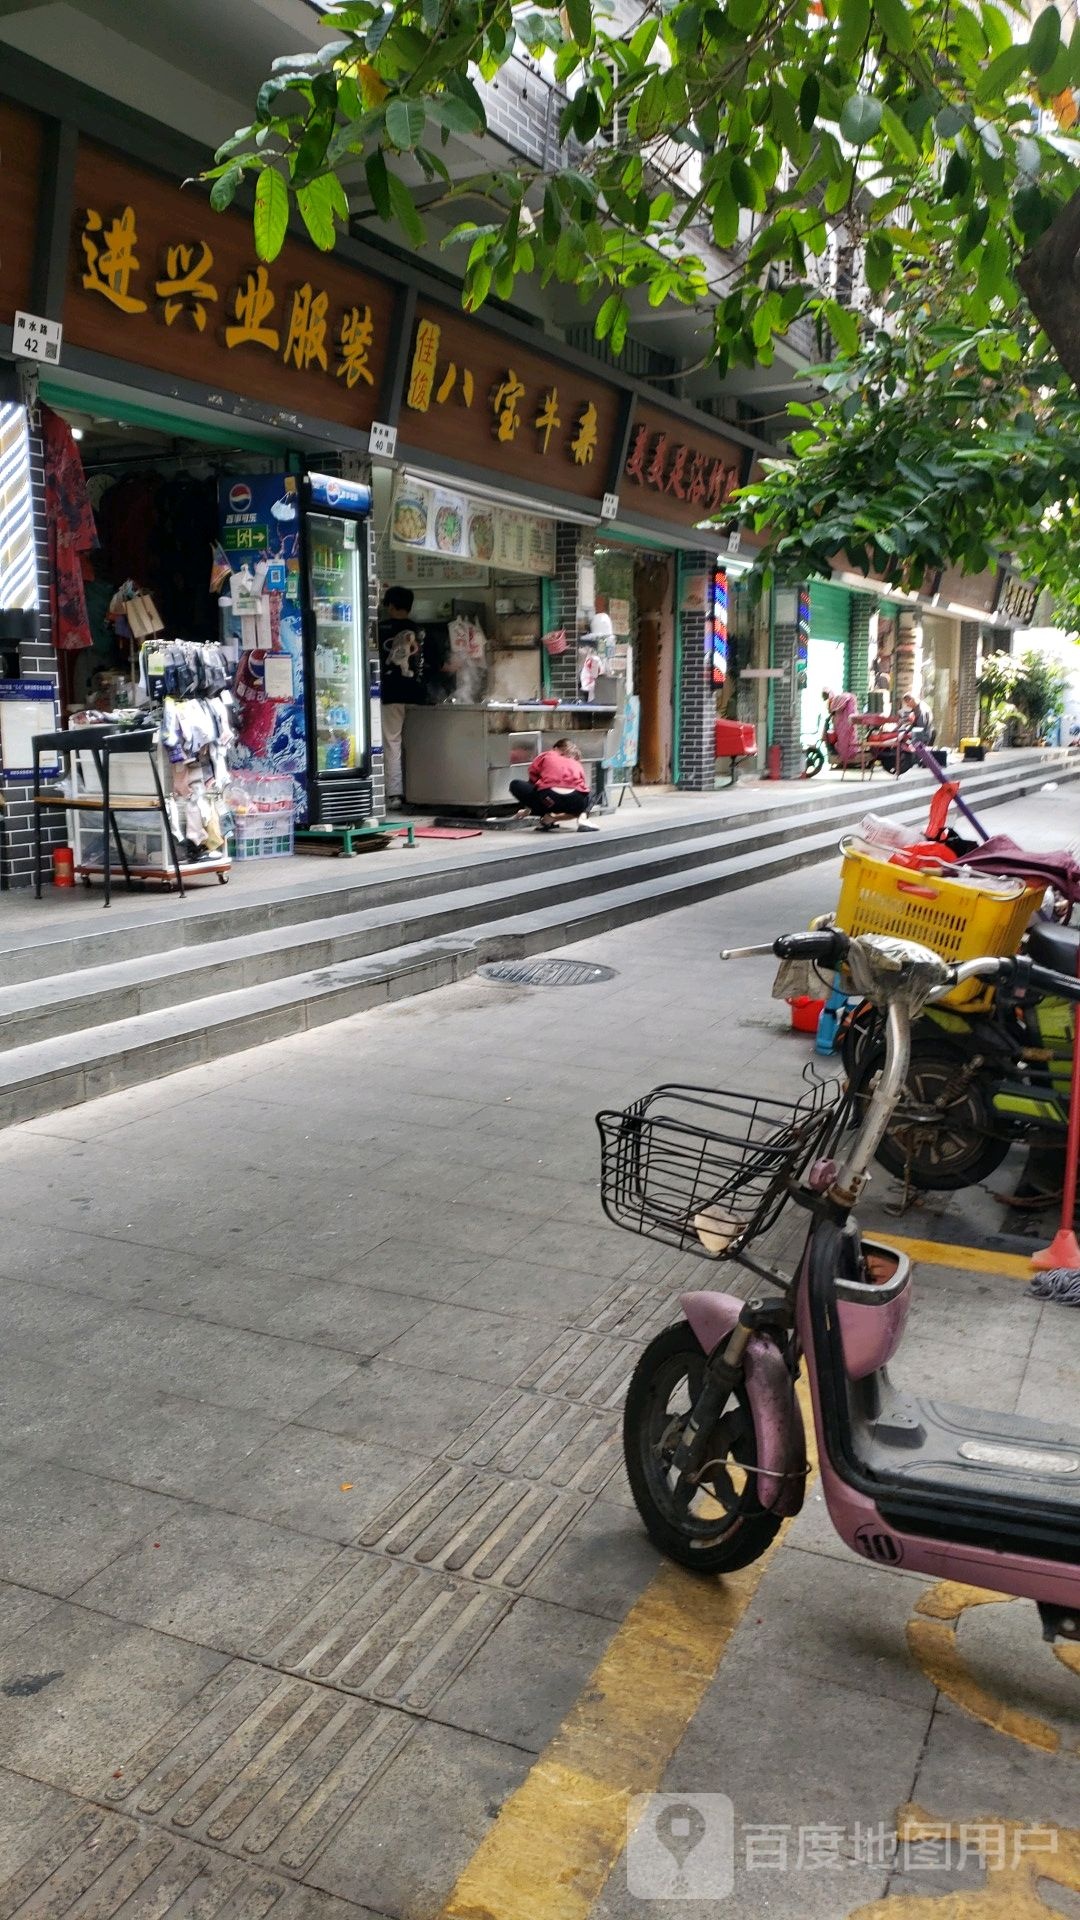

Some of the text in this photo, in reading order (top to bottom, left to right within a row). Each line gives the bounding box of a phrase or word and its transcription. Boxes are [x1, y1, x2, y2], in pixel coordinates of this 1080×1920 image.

[81, 205, 375, 389] 进兴业服装
[17, 317, 48, 336] 南水路
[24, 337, 38, 353] 42
[375, 440, 384, 451] 40
